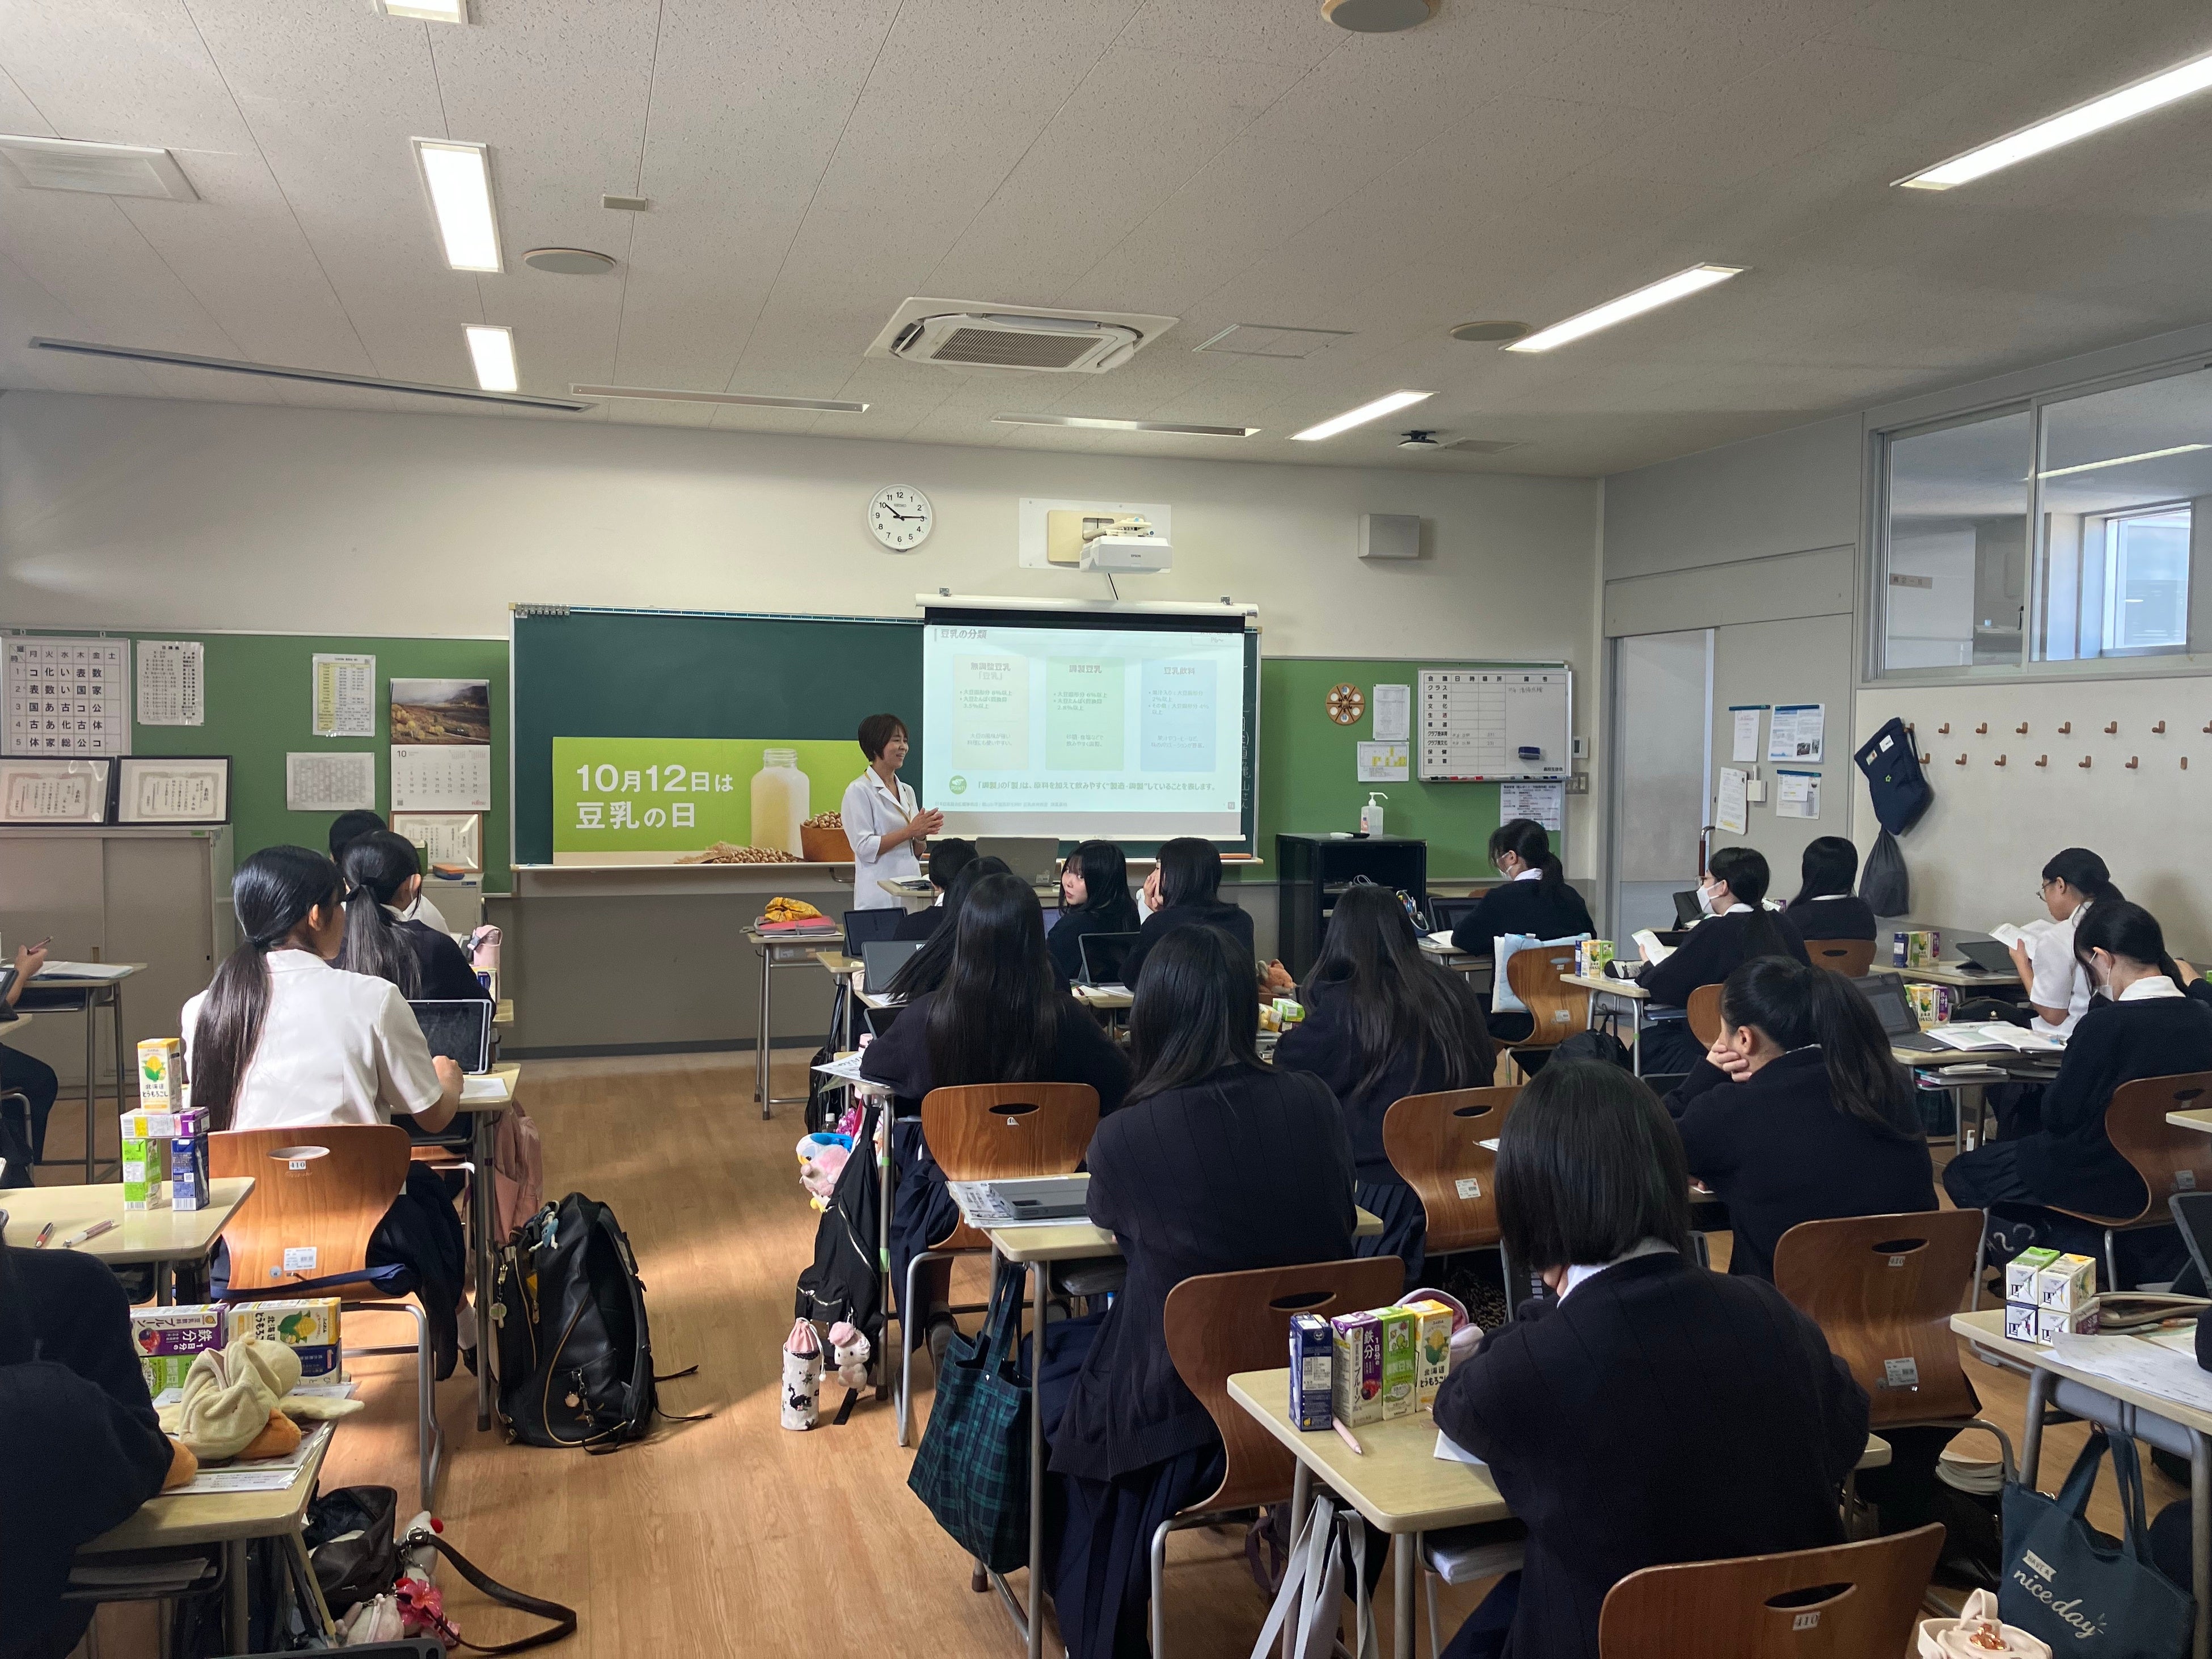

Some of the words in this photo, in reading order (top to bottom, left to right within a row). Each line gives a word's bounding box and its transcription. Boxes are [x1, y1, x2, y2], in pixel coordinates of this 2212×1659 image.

[940, 629, 987, 639] 豆乳の分類
[970, 662, 1011, 672] 無調整豆乳
[1069, 665, 1103, 674] 調製豆乳
[1163, 666, 1196, 675] 豆乳飲料
[45, 668, 54, 677] 化
[76, 669, 86, 678] 表
[92, 668, 102, 678] 数
[979, 672, 1003, 681] 「豆乳」
[29, 685, 39, 694] 表
[45, 685, 55, 694] 数
[77, 686, 86, 695] 国
[92, 686, 102, 695] 家
[29, 702, 39, 712] 国
[45, 702, 54, 711] あ
[61, 703, 70, 712] 古
[92, 704, 102, 712] 公
[29, 720, 39, 729] 古
[46, 720, 56, 729] あ
[61, 720, 71, 729] 化
[77, 721, 87, 729] 古
[92, 721, 103, 730] 体
[29, 738, 40, 747] 体
[45, 738, 55, 747] 家
[77, 738, 87, 747] 公
[576, 763, 734, 792] 10月12日は
[576, 801, 695, 829] 豆乳の日
[137, 1318, 176, 1328] プルーン
[183, 1329, 213, 1343] 鉄分
[1363, 1329, 1374, 1360] 鉄分
[1424, 1366, 1445, 1376] 北海道
[2013, 1569, 2054, 1604] nice
[2051, 1599, 2096, 1639] day
[1795, 1614, 1818, 1626] 410
